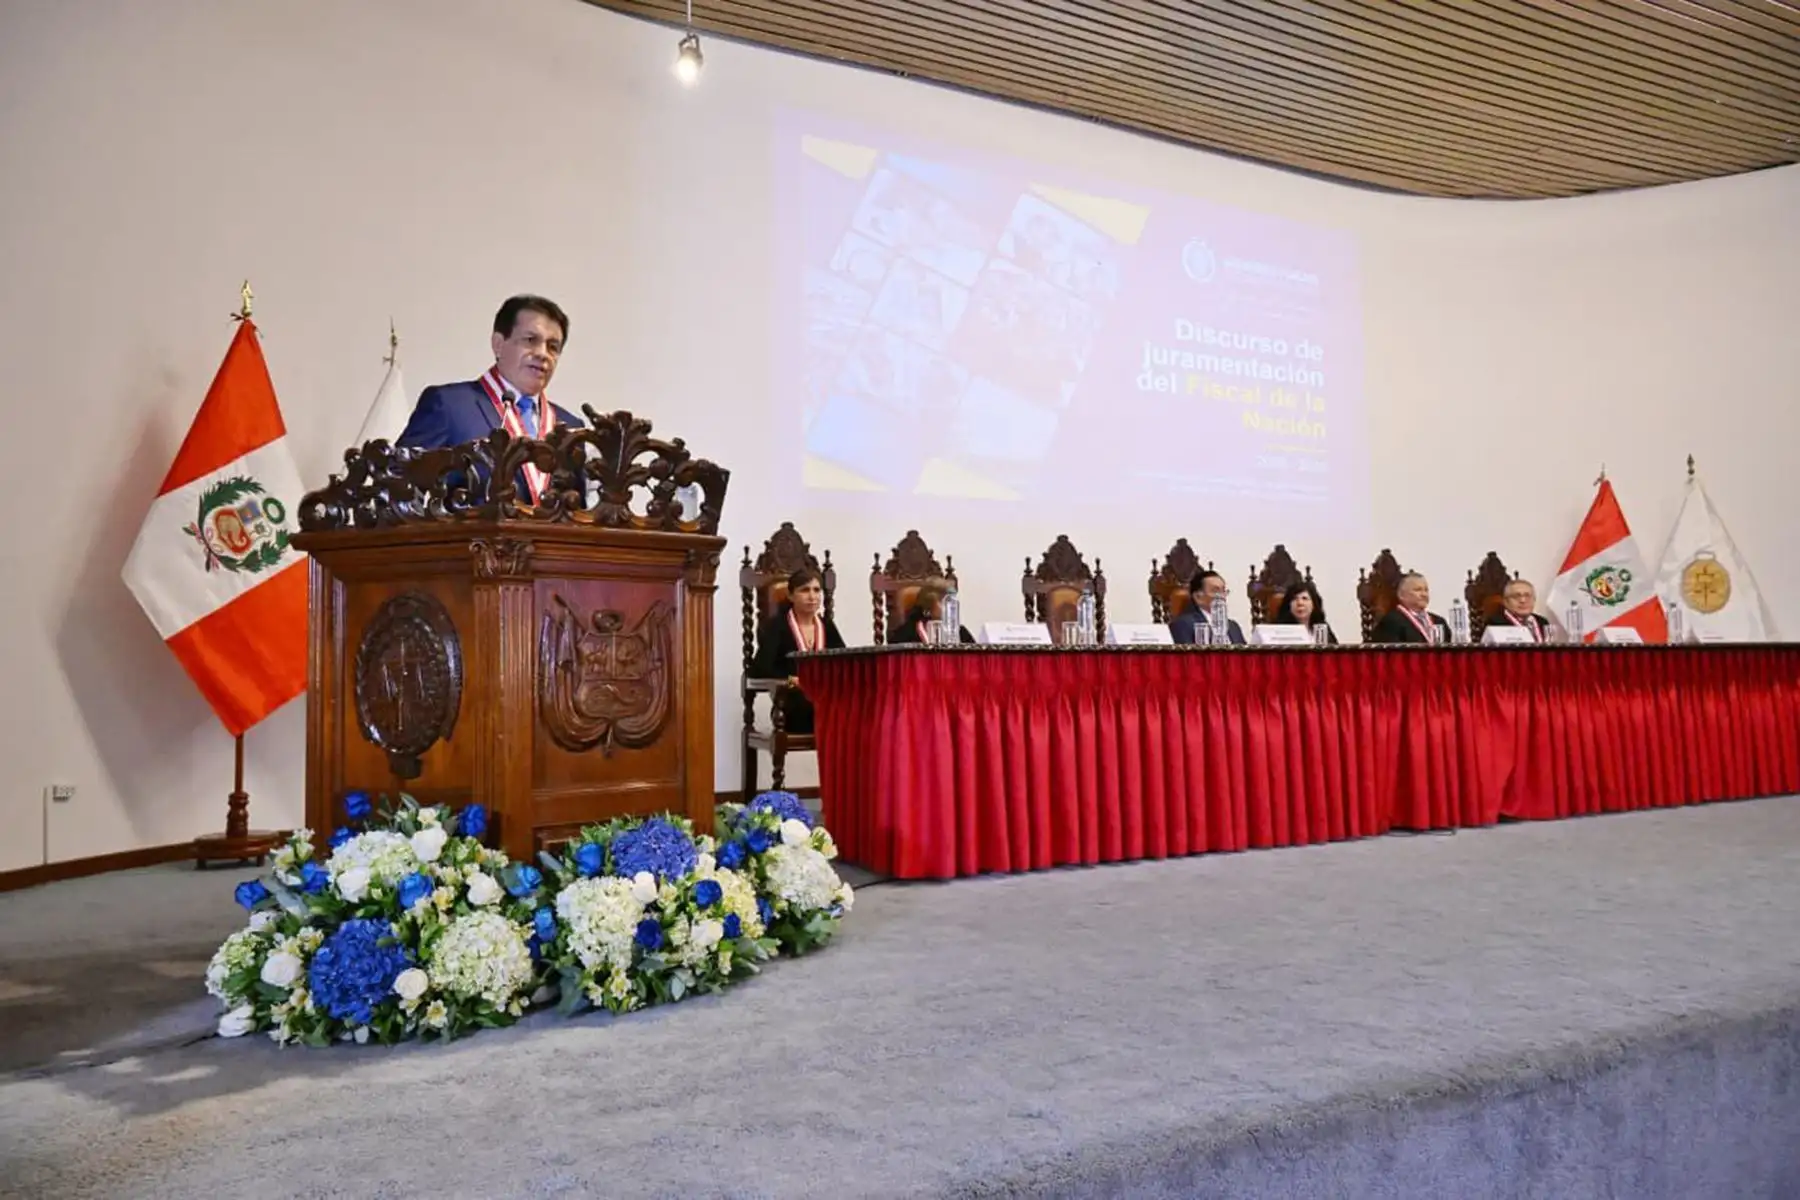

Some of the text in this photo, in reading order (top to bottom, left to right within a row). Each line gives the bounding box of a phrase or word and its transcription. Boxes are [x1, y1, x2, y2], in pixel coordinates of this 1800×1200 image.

[1175, 318, 1323, 361] Discurso de
[1144, 341, 1324, 388] juramentación
[1136, 369, 1326, 413] del Fiscal de la
[1242, 410, 1327, 438] Nación
